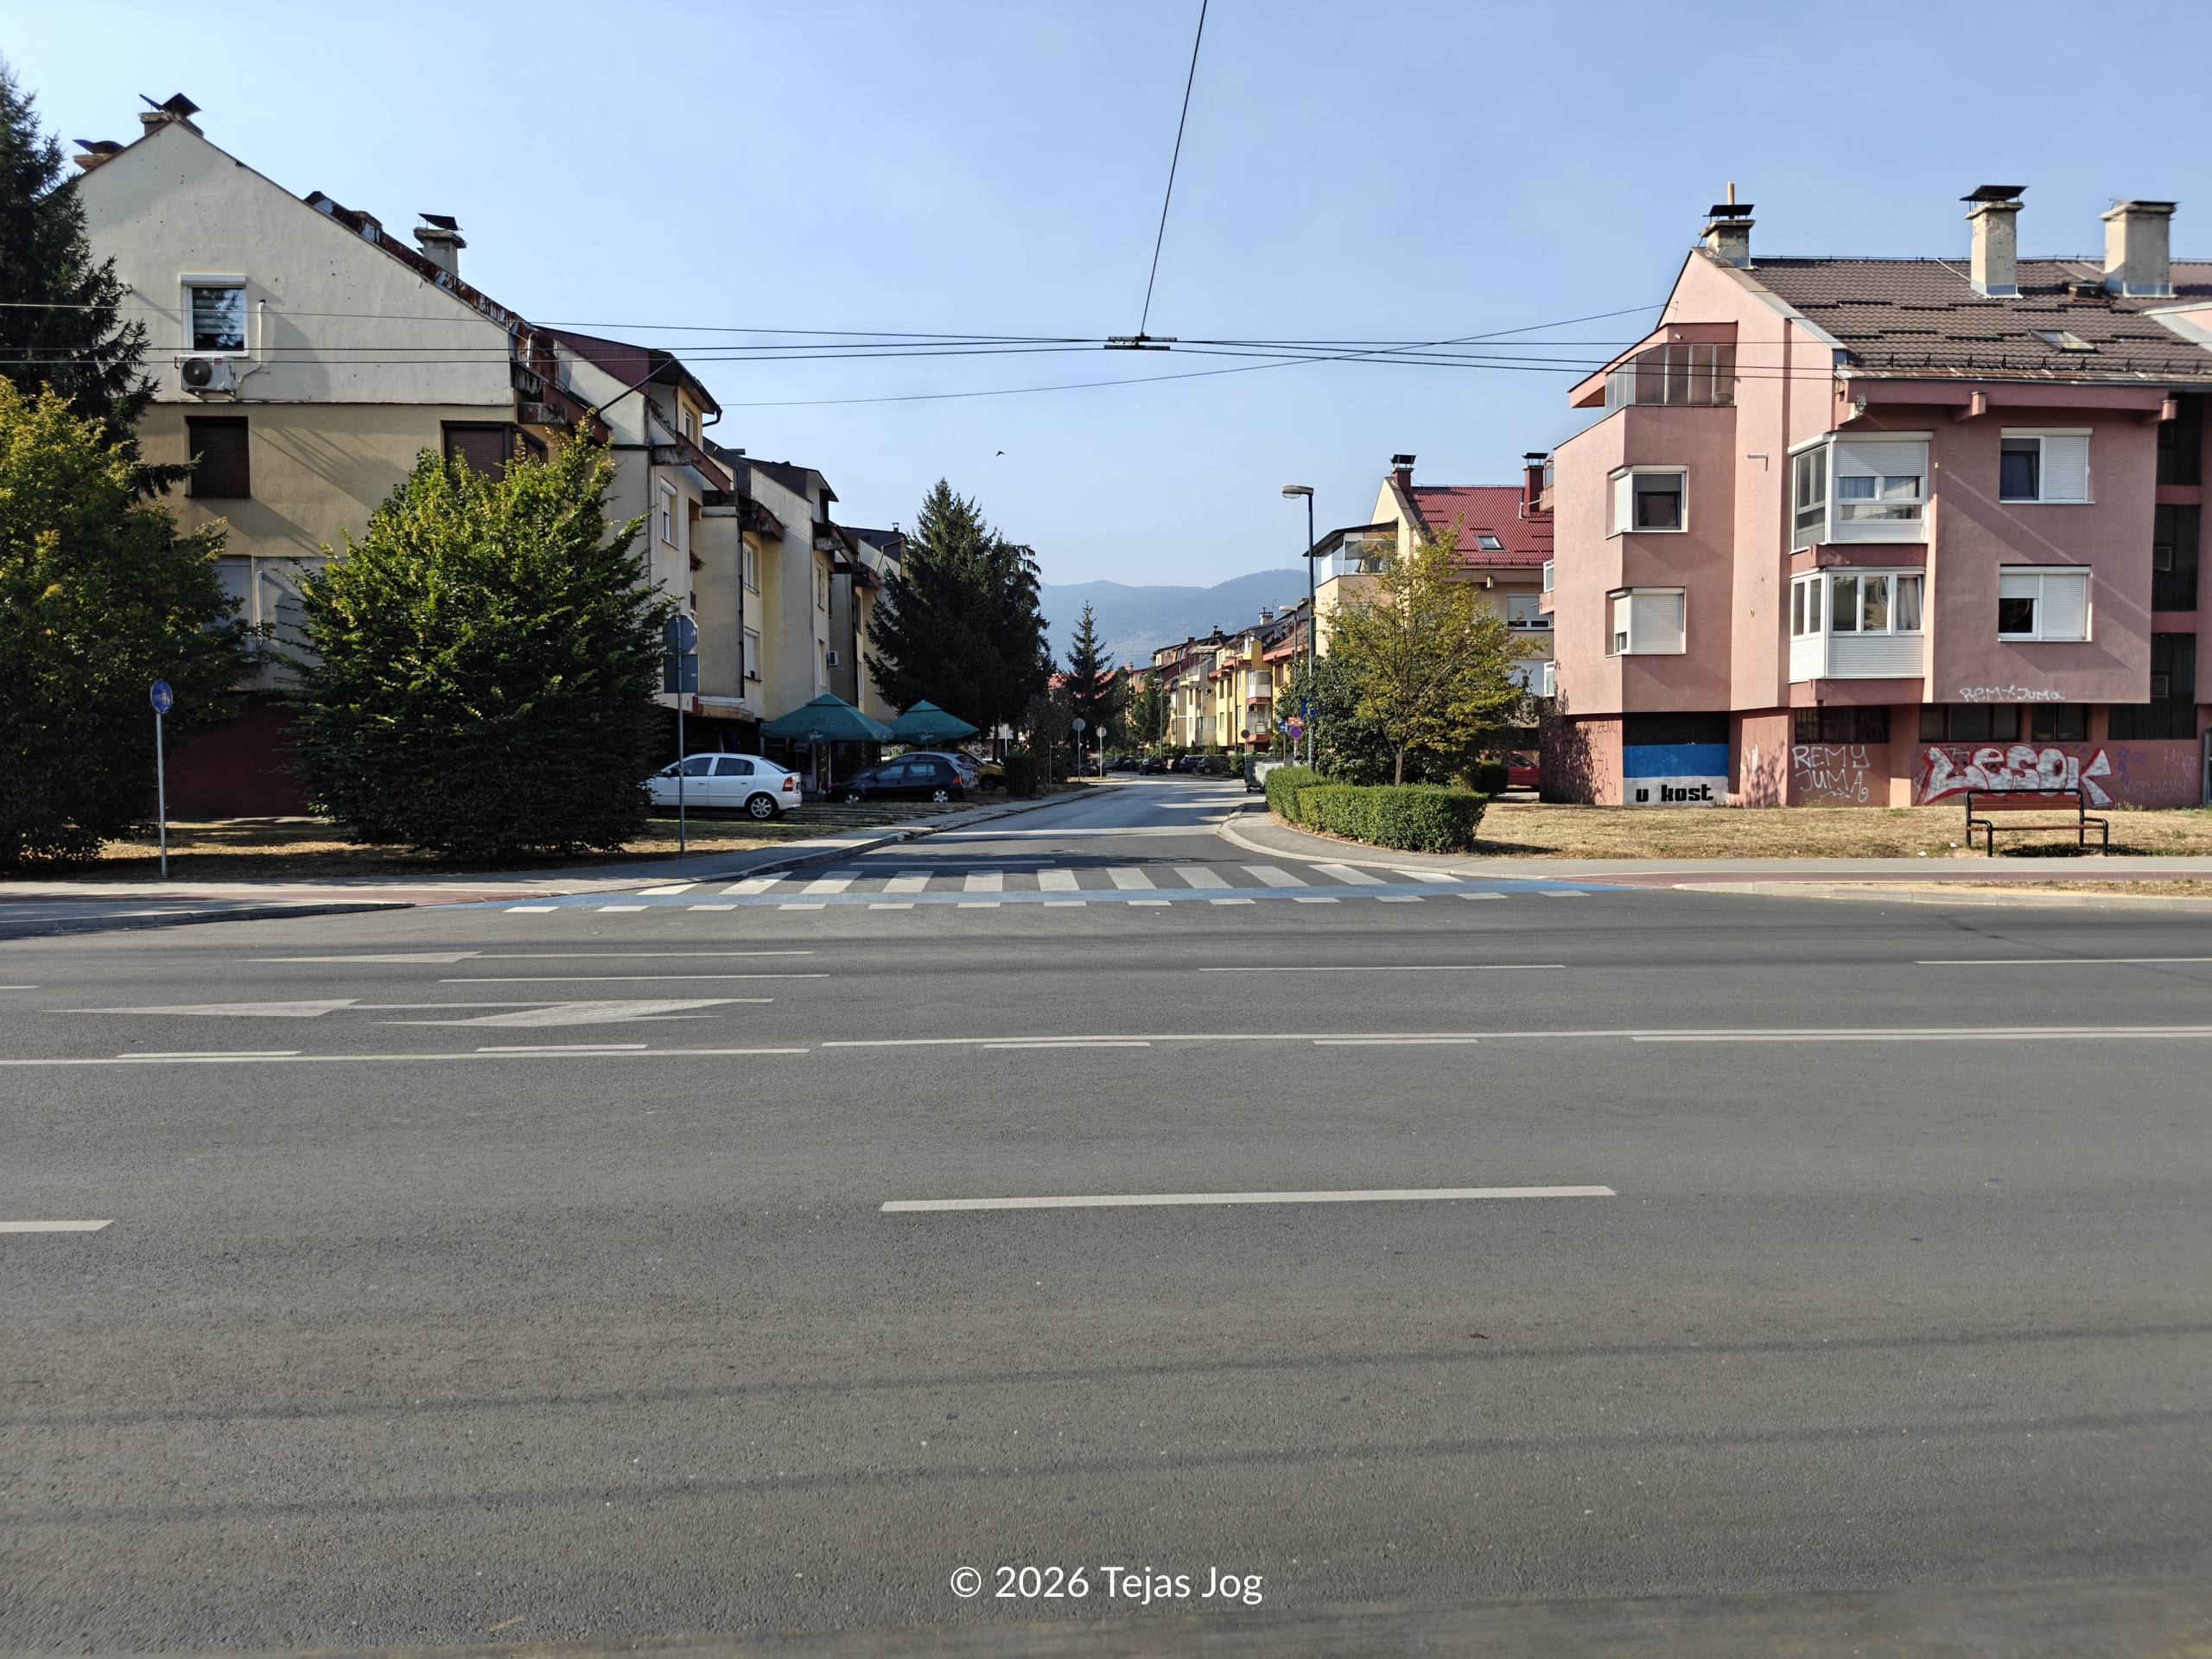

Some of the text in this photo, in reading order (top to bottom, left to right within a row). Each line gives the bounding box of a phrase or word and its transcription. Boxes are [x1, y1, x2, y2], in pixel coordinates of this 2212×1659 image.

[1791, 746, 1871, 769] REMY
[1636, 787, 1649, 802] u
[1661, 784, 1713, 802] kost
[1795, 768, 1869, 803] JUMA
